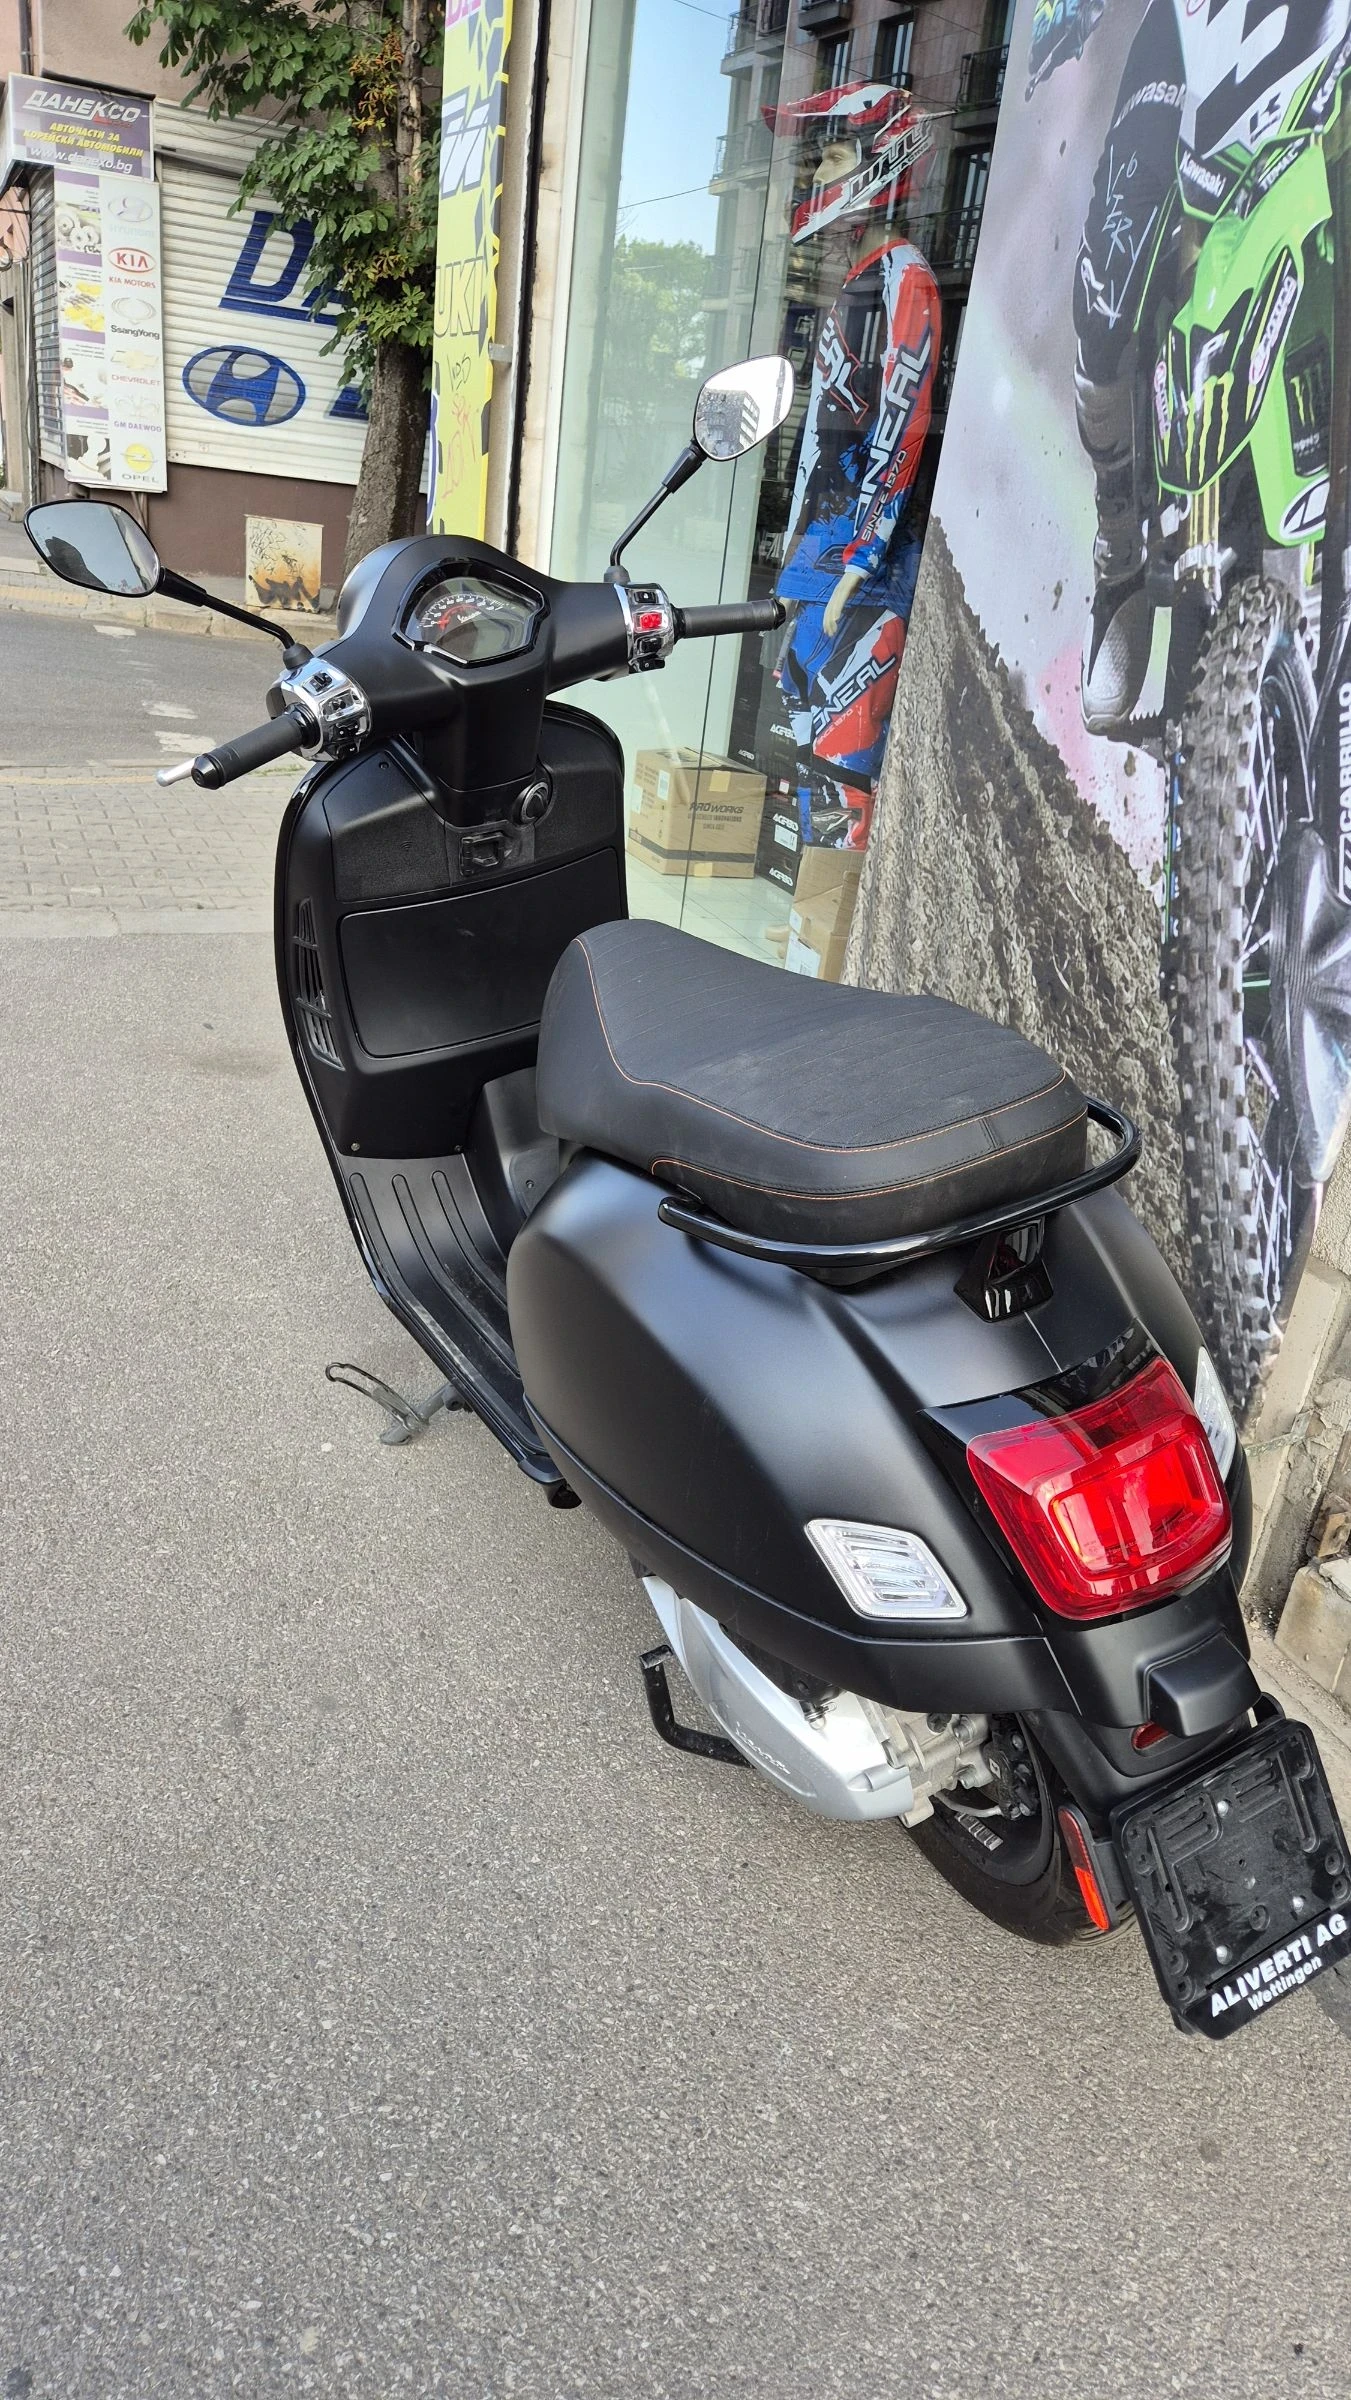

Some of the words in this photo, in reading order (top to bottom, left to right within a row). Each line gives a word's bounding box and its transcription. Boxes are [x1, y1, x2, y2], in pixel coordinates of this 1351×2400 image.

[49, 122, 105, 139] АВТОЧАСТИ
[107, 132, 121, 142] ЗА
[23, 129, 75, 145] КОРЕЙСКИ
[77, 137, 144, 157] АВТОМОБИЛИ
[29, 147, 133, 174] www.danexo.bg
[1179, 150, 1227, 198] Kawasaki
[116, 252, 149, 269] KIA
[108, 276, 122, 284] KIA
[124, 278, 156, 289] MOTORS
[110, 324, 160, 340] SsangYong
[111, 374, 161, 386] CHEVROLET
[114, 420, 126, 429] GM
[128, 422, 162, 433] DAEWOO
[122, 473, 160, 484] OPEL
[861, 490, 889, 543] SINCE
[885, 449, 908, 490] 1970
[1211, 1934, 1313, 2018] ALIVERTI
[1316, 1913, 1348, 1948] AG
[1247, 1955, 1323, 2011] Wettingen
